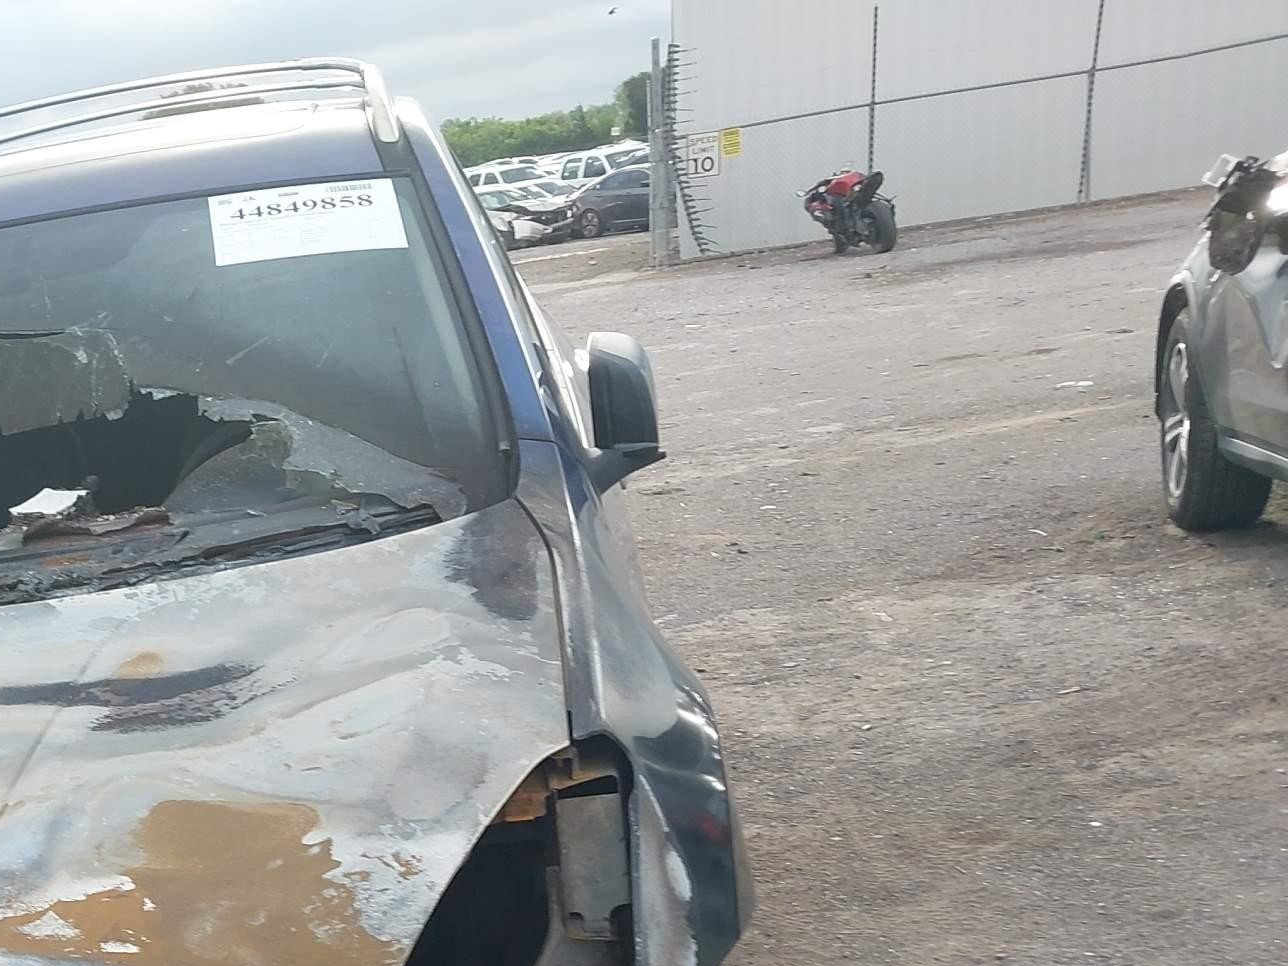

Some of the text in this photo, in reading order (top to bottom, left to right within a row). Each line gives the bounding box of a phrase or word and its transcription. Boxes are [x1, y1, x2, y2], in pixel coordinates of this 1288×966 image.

[689, 135, 717, 145] SPEED
[692, 156, 715, 174] 10
[230, 193, 374, 220] 44849858
